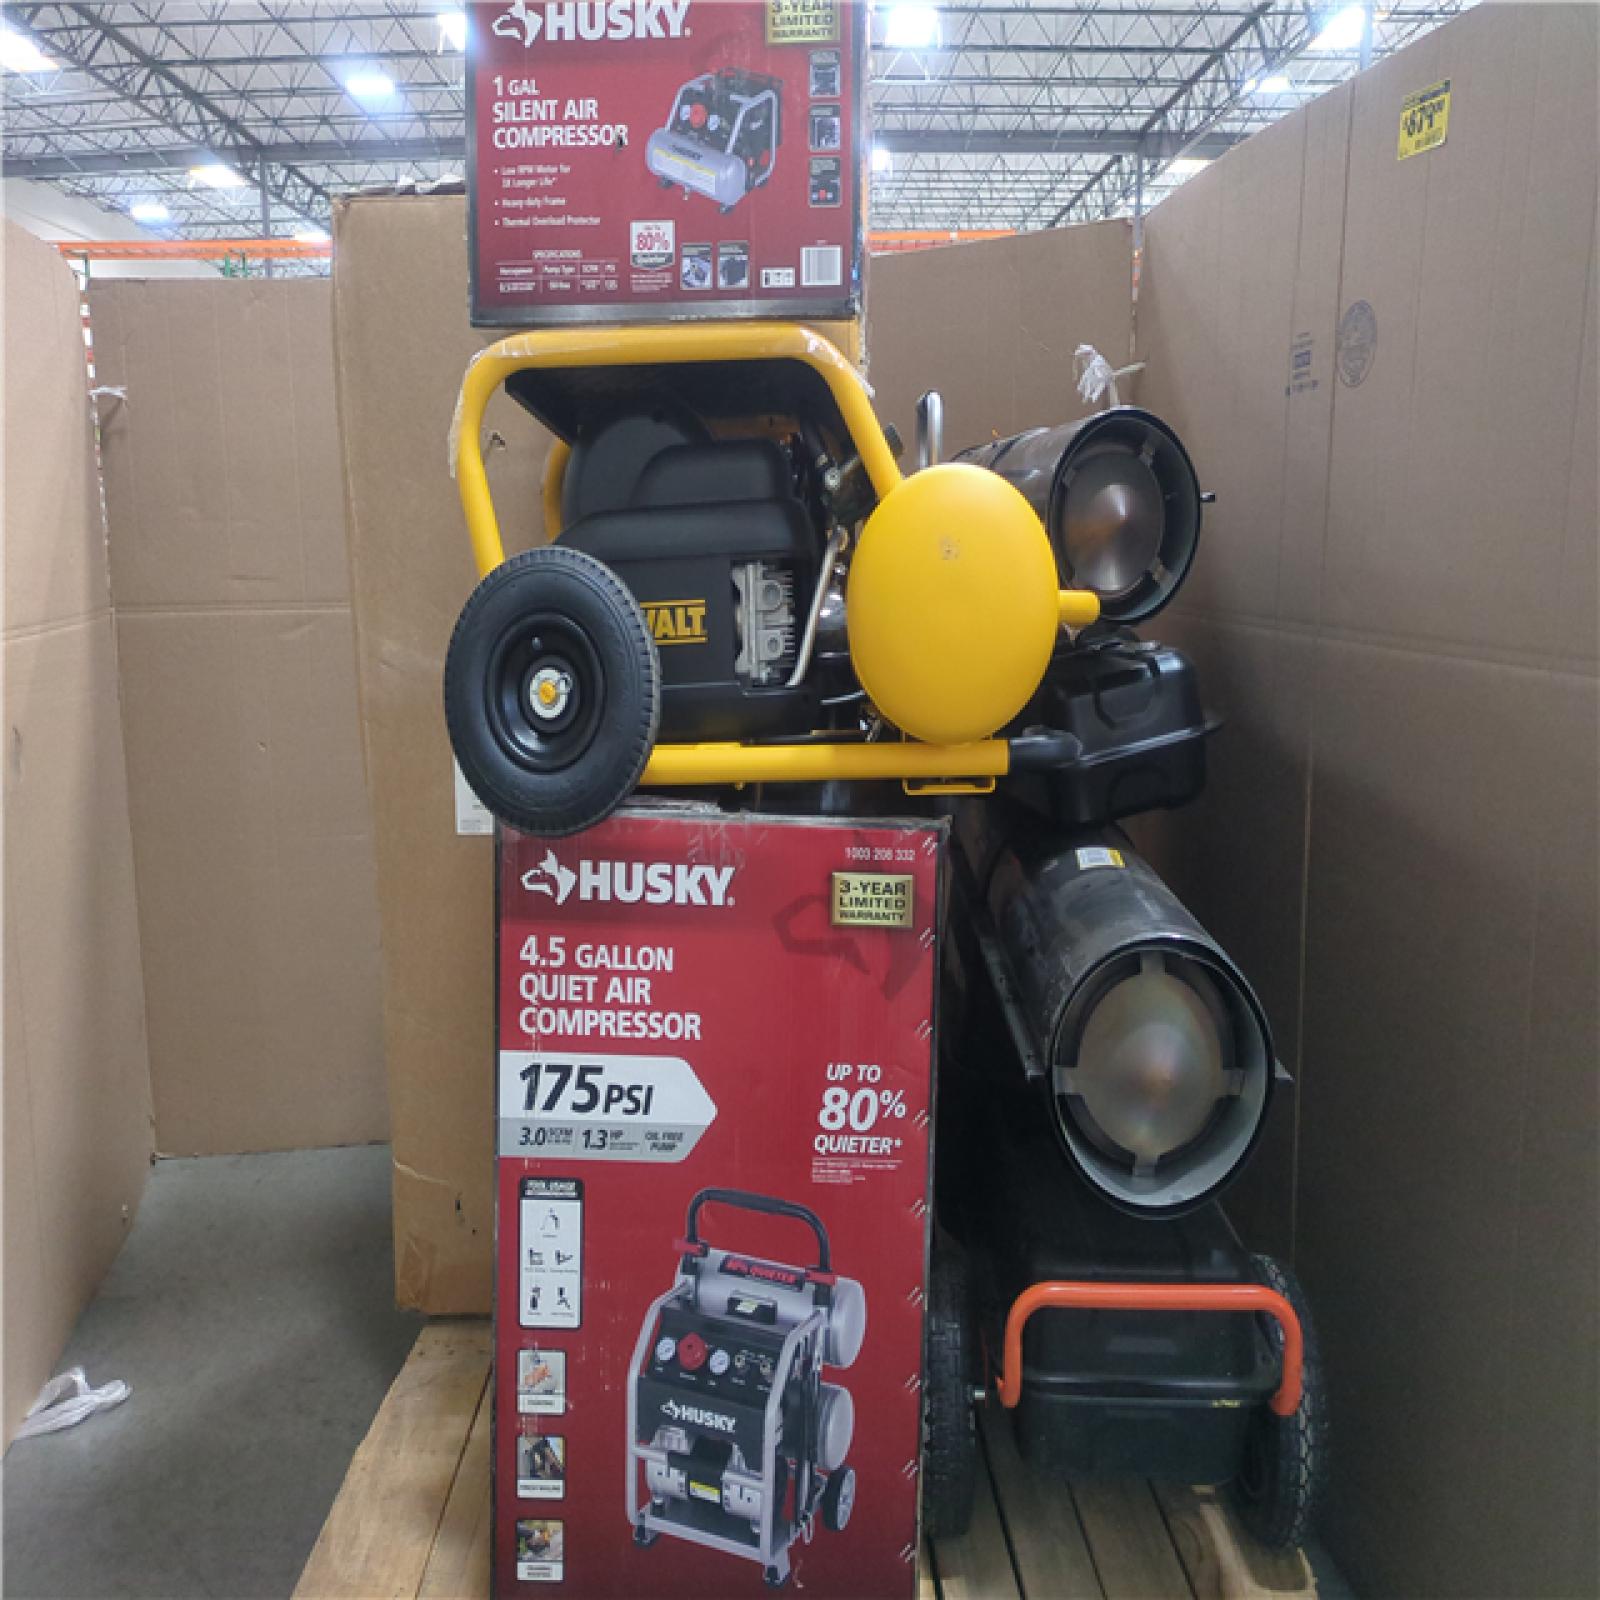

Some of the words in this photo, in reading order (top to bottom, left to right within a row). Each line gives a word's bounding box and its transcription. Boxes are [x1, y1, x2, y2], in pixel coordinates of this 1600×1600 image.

[545, 0, 691, 41] HUSKY
[772, 14, 833, 26] LIMITED
[493, 75, 503, 96] 1
[508, 79, 541, 95] GAL
[493, 100, 558, 123] SILENT
[564, 98, 598, 120] AIR
[493, 124, 629, 148] COMPRESSOR
[579, 859, 736, 906] HUSKY
[839, 880, 906, 896] 3-YEAR
[839, 897, 906, 910] LIMITED
[839, 910, 904, 921] WARRANTY
[519, 935, 566, 968] 4.5
[575, 944, 675, 972] GALLON
[519, 972, 599, 1005] QUIET
[604, 976, 652, 1005] AIR
[519, 1006, 702, 1041] COMPRESSOR
[827, 1063, 853, 1081] UP
[857, 1064, 882, 1083] TO
[819, 1086, 907, 1132] 80%
[519, 1127, 546, 1146] 3.0
[582, 1129, 608, 1149] 1.3
[609, 1130, 624, 1140] HP
[682, 1404, 737, 1433] HUSKY
